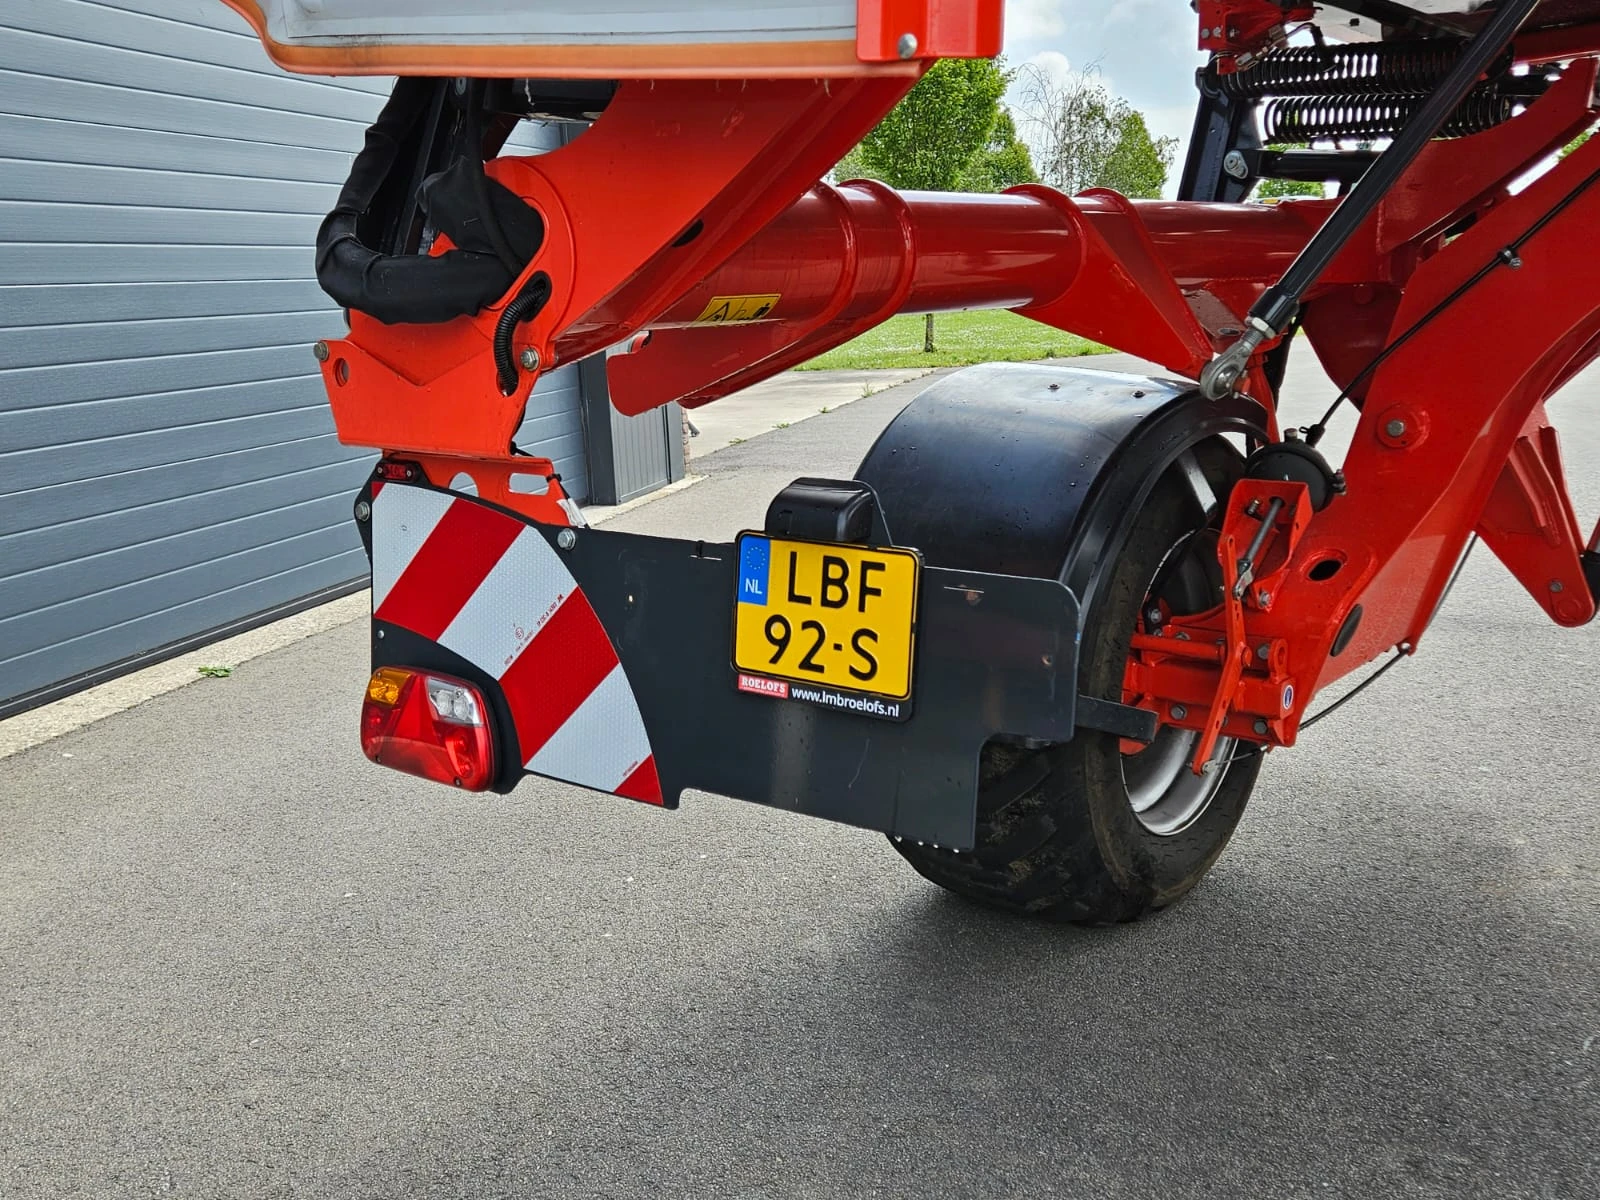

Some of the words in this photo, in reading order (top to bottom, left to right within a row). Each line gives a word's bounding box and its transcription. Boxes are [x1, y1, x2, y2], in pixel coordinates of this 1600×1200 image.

[745, 578, 762, 595] NL
[787, 551, 886, 613] LBF
[764, 614, 878, 682] 92-S
[741, 675, 786, 693] ROELOFS
[791, 687, 900, 717] www.lmbroelofs.nl
